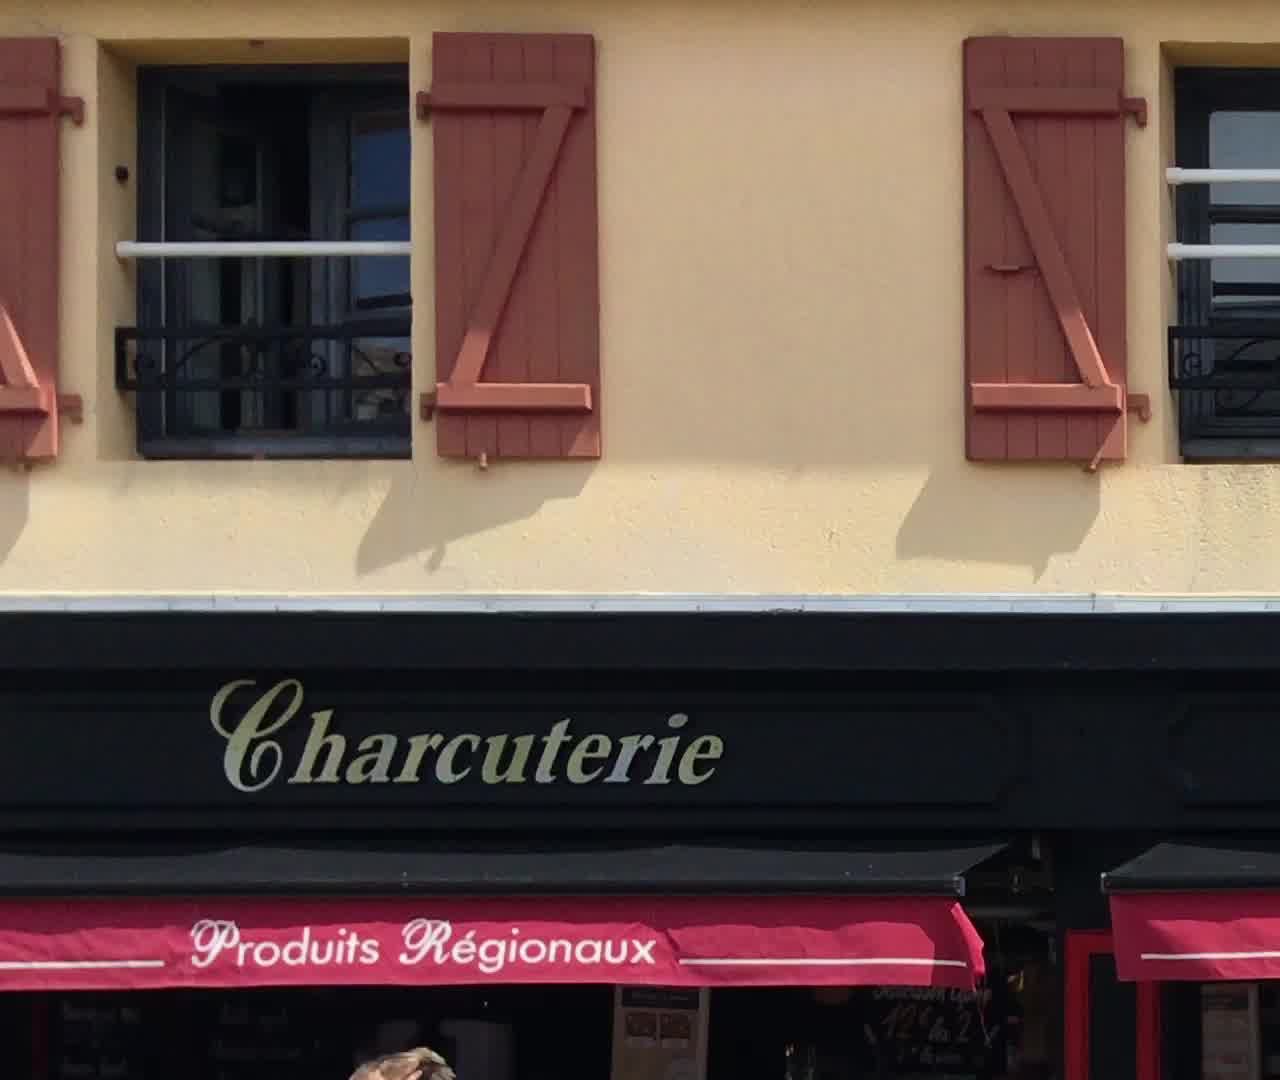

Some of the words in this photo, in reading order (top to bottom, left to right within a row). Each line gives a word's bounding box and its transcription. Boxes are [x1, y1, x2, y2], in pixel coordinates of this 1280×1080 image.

[209, 678, 725, 793] Charcuterie
[190, 918, 380, 969] Produits
[398, 917, 657, 975] Régionaux
